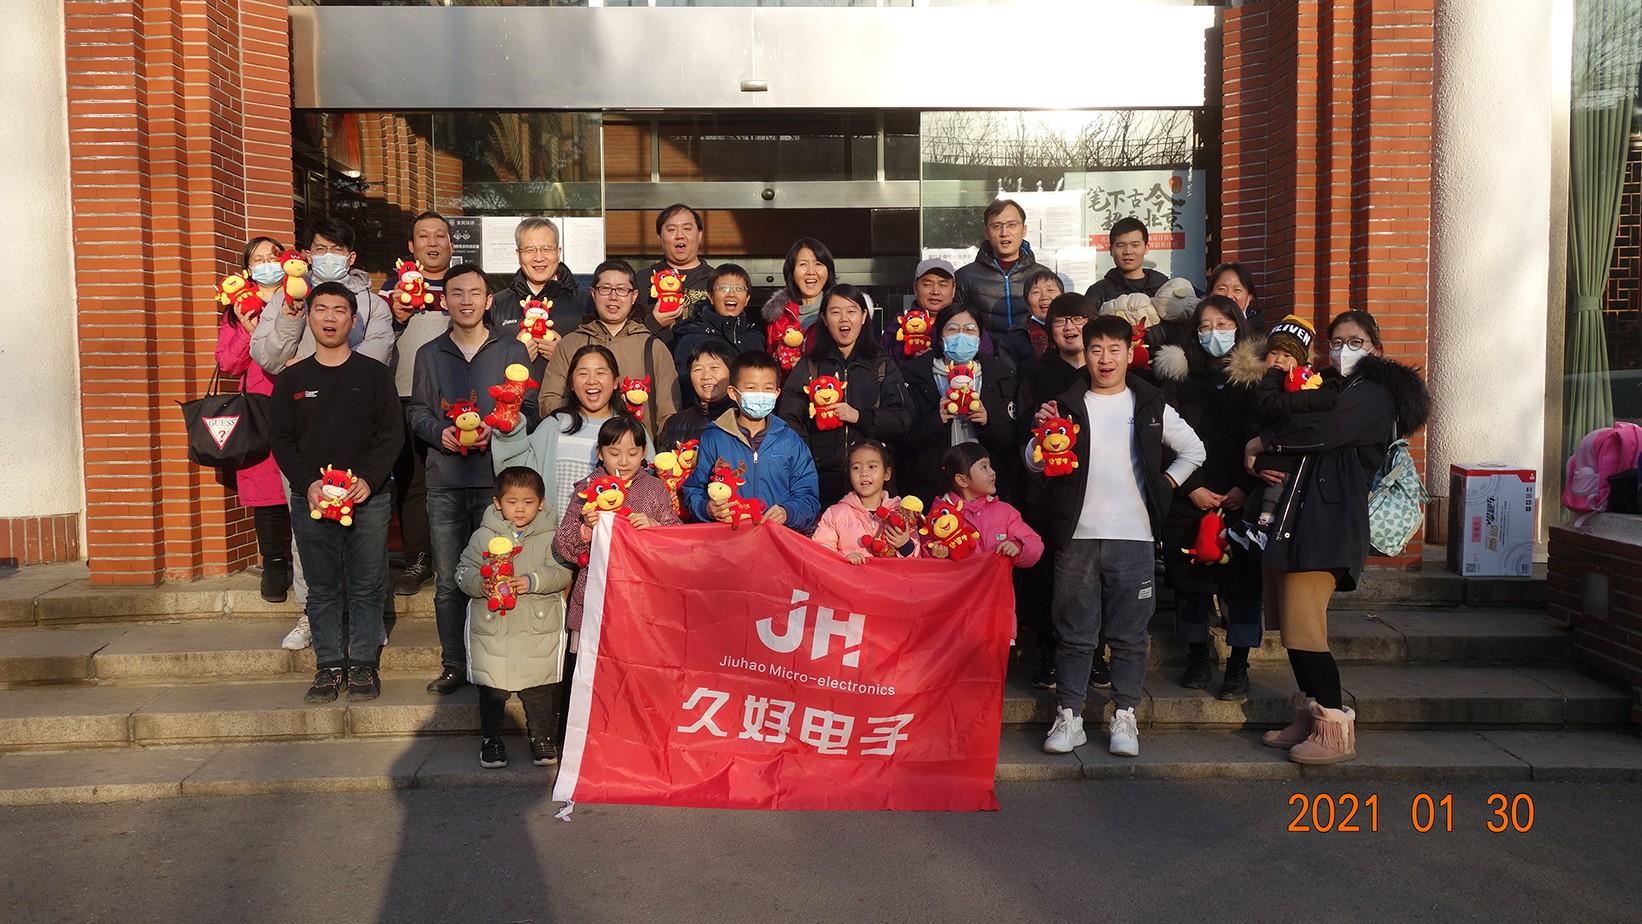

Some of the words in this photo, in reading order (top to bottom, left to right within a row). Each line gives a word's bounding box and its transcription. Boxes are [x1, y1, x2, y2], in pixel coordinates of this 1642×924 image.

[1271, 324, 1311, 346] LIVEN
[208, 419, 236, 427] GUESS
[719, 655, 766, 673] Jiuhao
[769, 663, 896, 696] Micro-electronics
[677, 687, 915, 756] 久好电子
